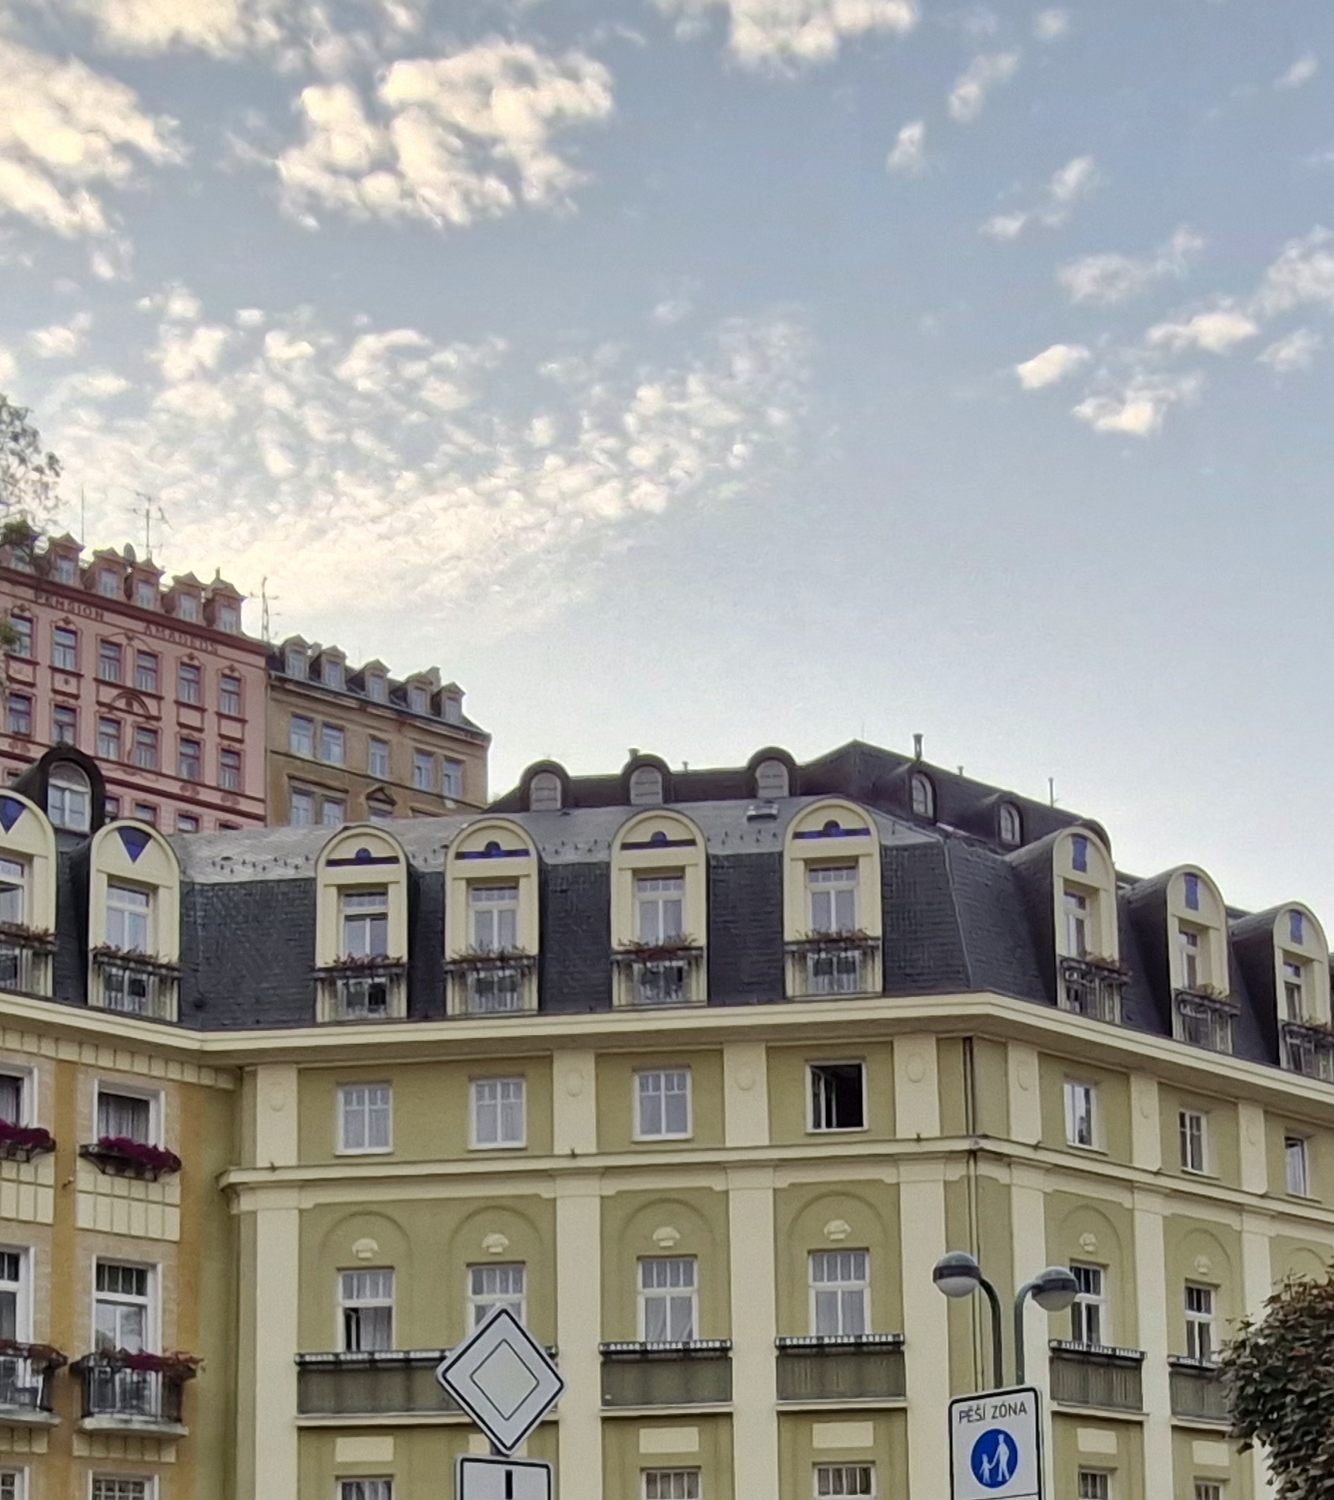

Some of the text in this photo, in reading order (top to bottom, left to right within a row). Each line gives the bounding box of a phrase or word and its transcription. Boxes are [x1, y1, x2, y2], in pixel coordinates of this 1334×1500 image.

[34, 589, 217, 653] PENSION AMADEUS
[958, 1401, 1027, 1424] PĚŠÍ ZÓNA
